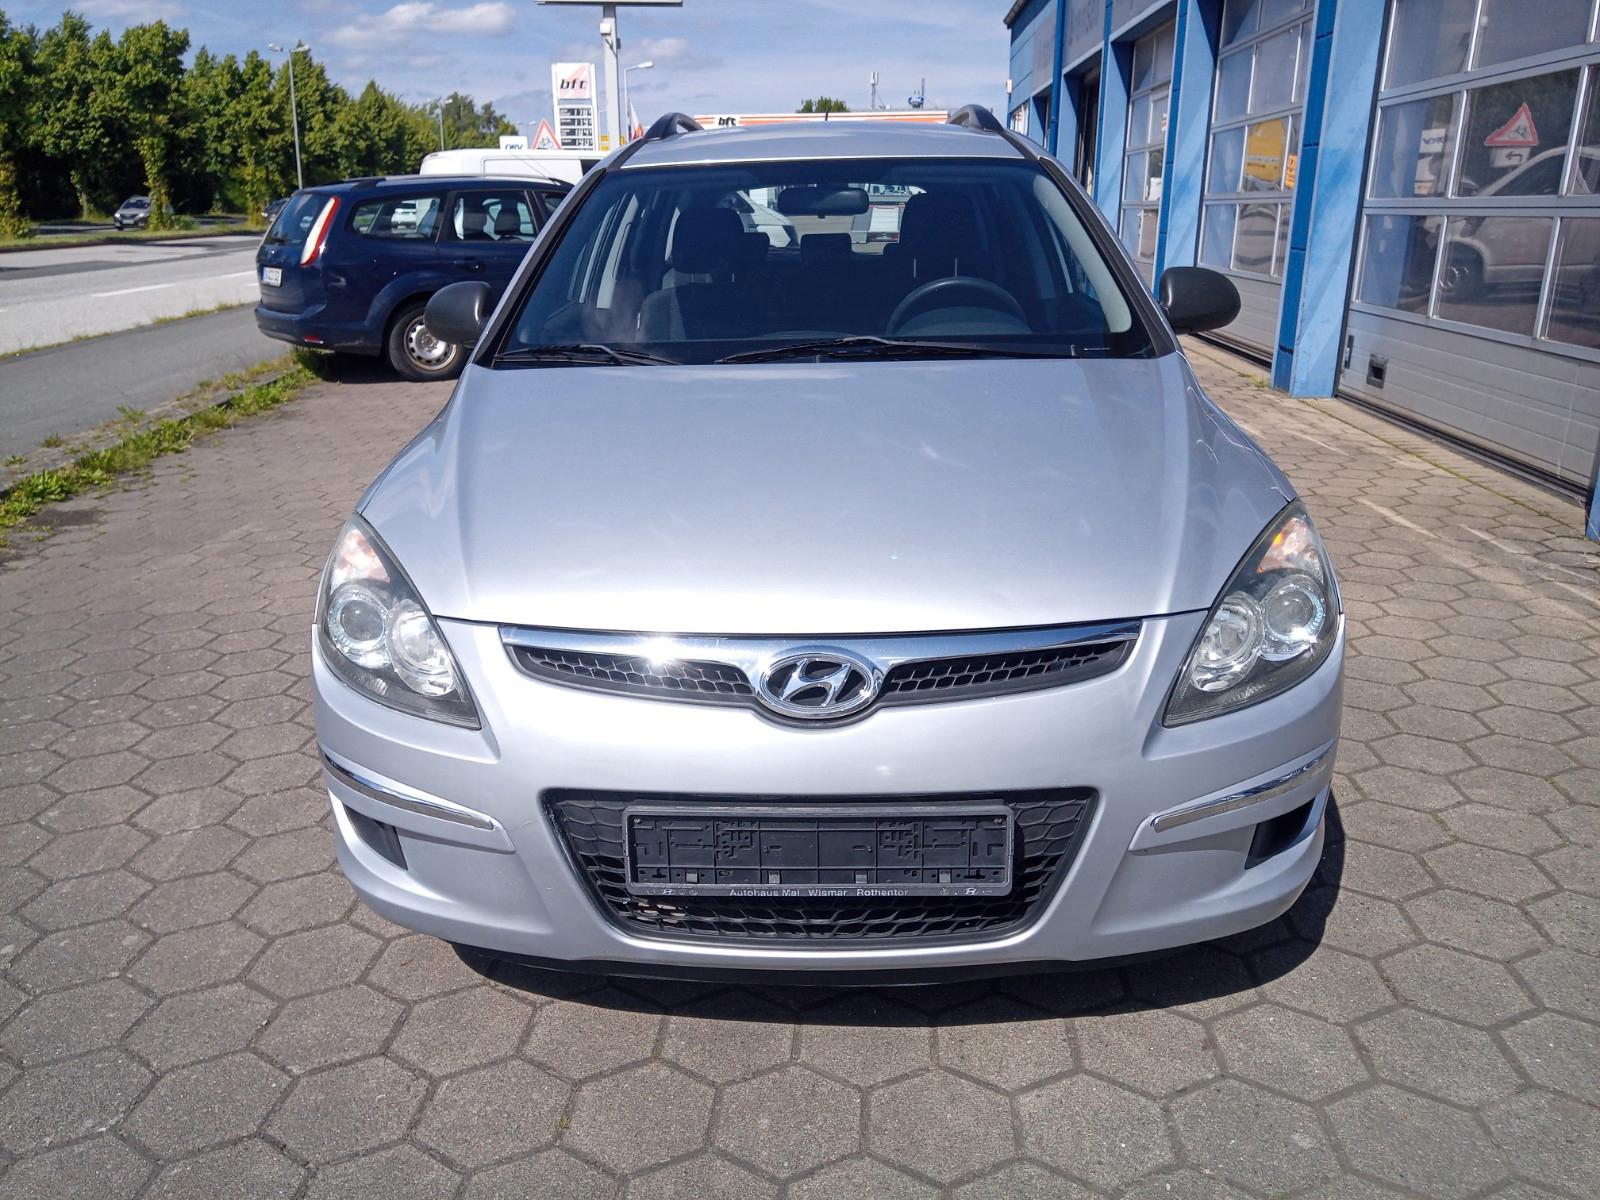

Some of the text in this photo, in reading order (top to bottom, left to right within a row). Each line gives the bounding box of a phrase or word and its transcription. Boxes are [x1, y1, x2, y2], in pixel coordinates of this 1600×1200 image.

[560, 77, 588, 89] bft
[718, 116, 737, 127] bft
[729, 889, 779, 897] Autohaus
[808, 889, 847, 897] Wismar
[856, 889, 909, 897] Rothentor
